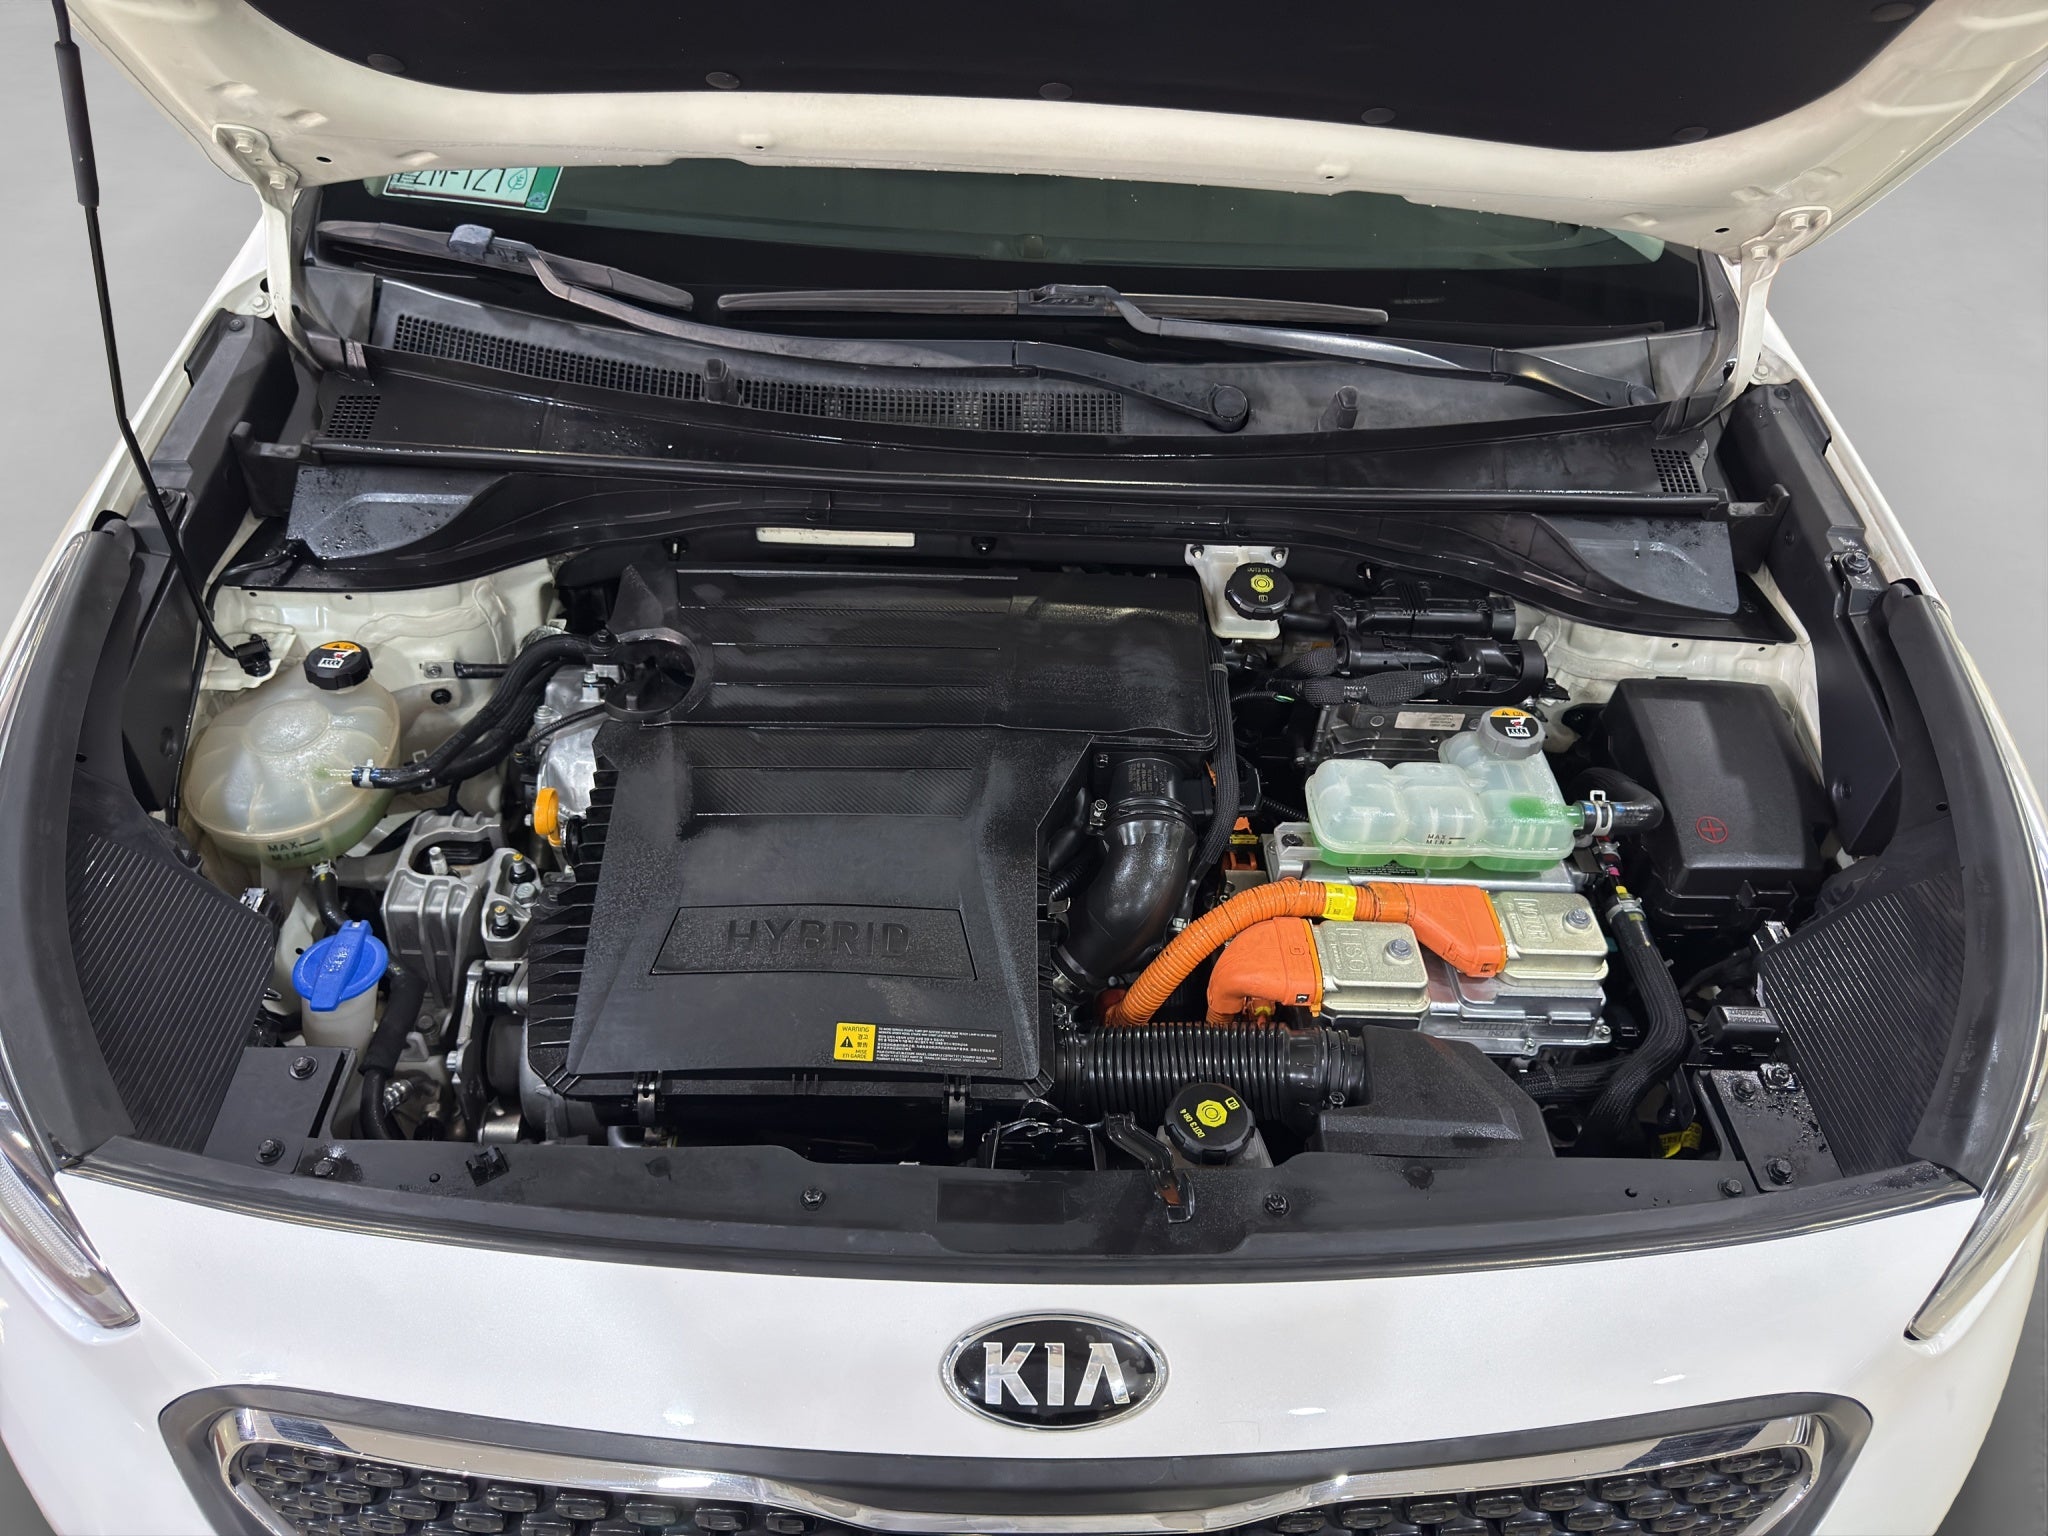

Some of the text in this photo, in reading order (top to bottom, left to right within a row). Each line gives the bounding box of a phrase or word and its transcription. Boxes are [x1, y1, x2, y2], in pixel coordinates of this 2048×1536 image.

[267, 841, 298, 852] MAX
[271, 851, 302, 861] MIN
[726, 918, 911, 957] HYBRID
[1179, 1107, 1206, 1139] DOT3 OR 4
[982, 1341, 1132, 1406] KIA
